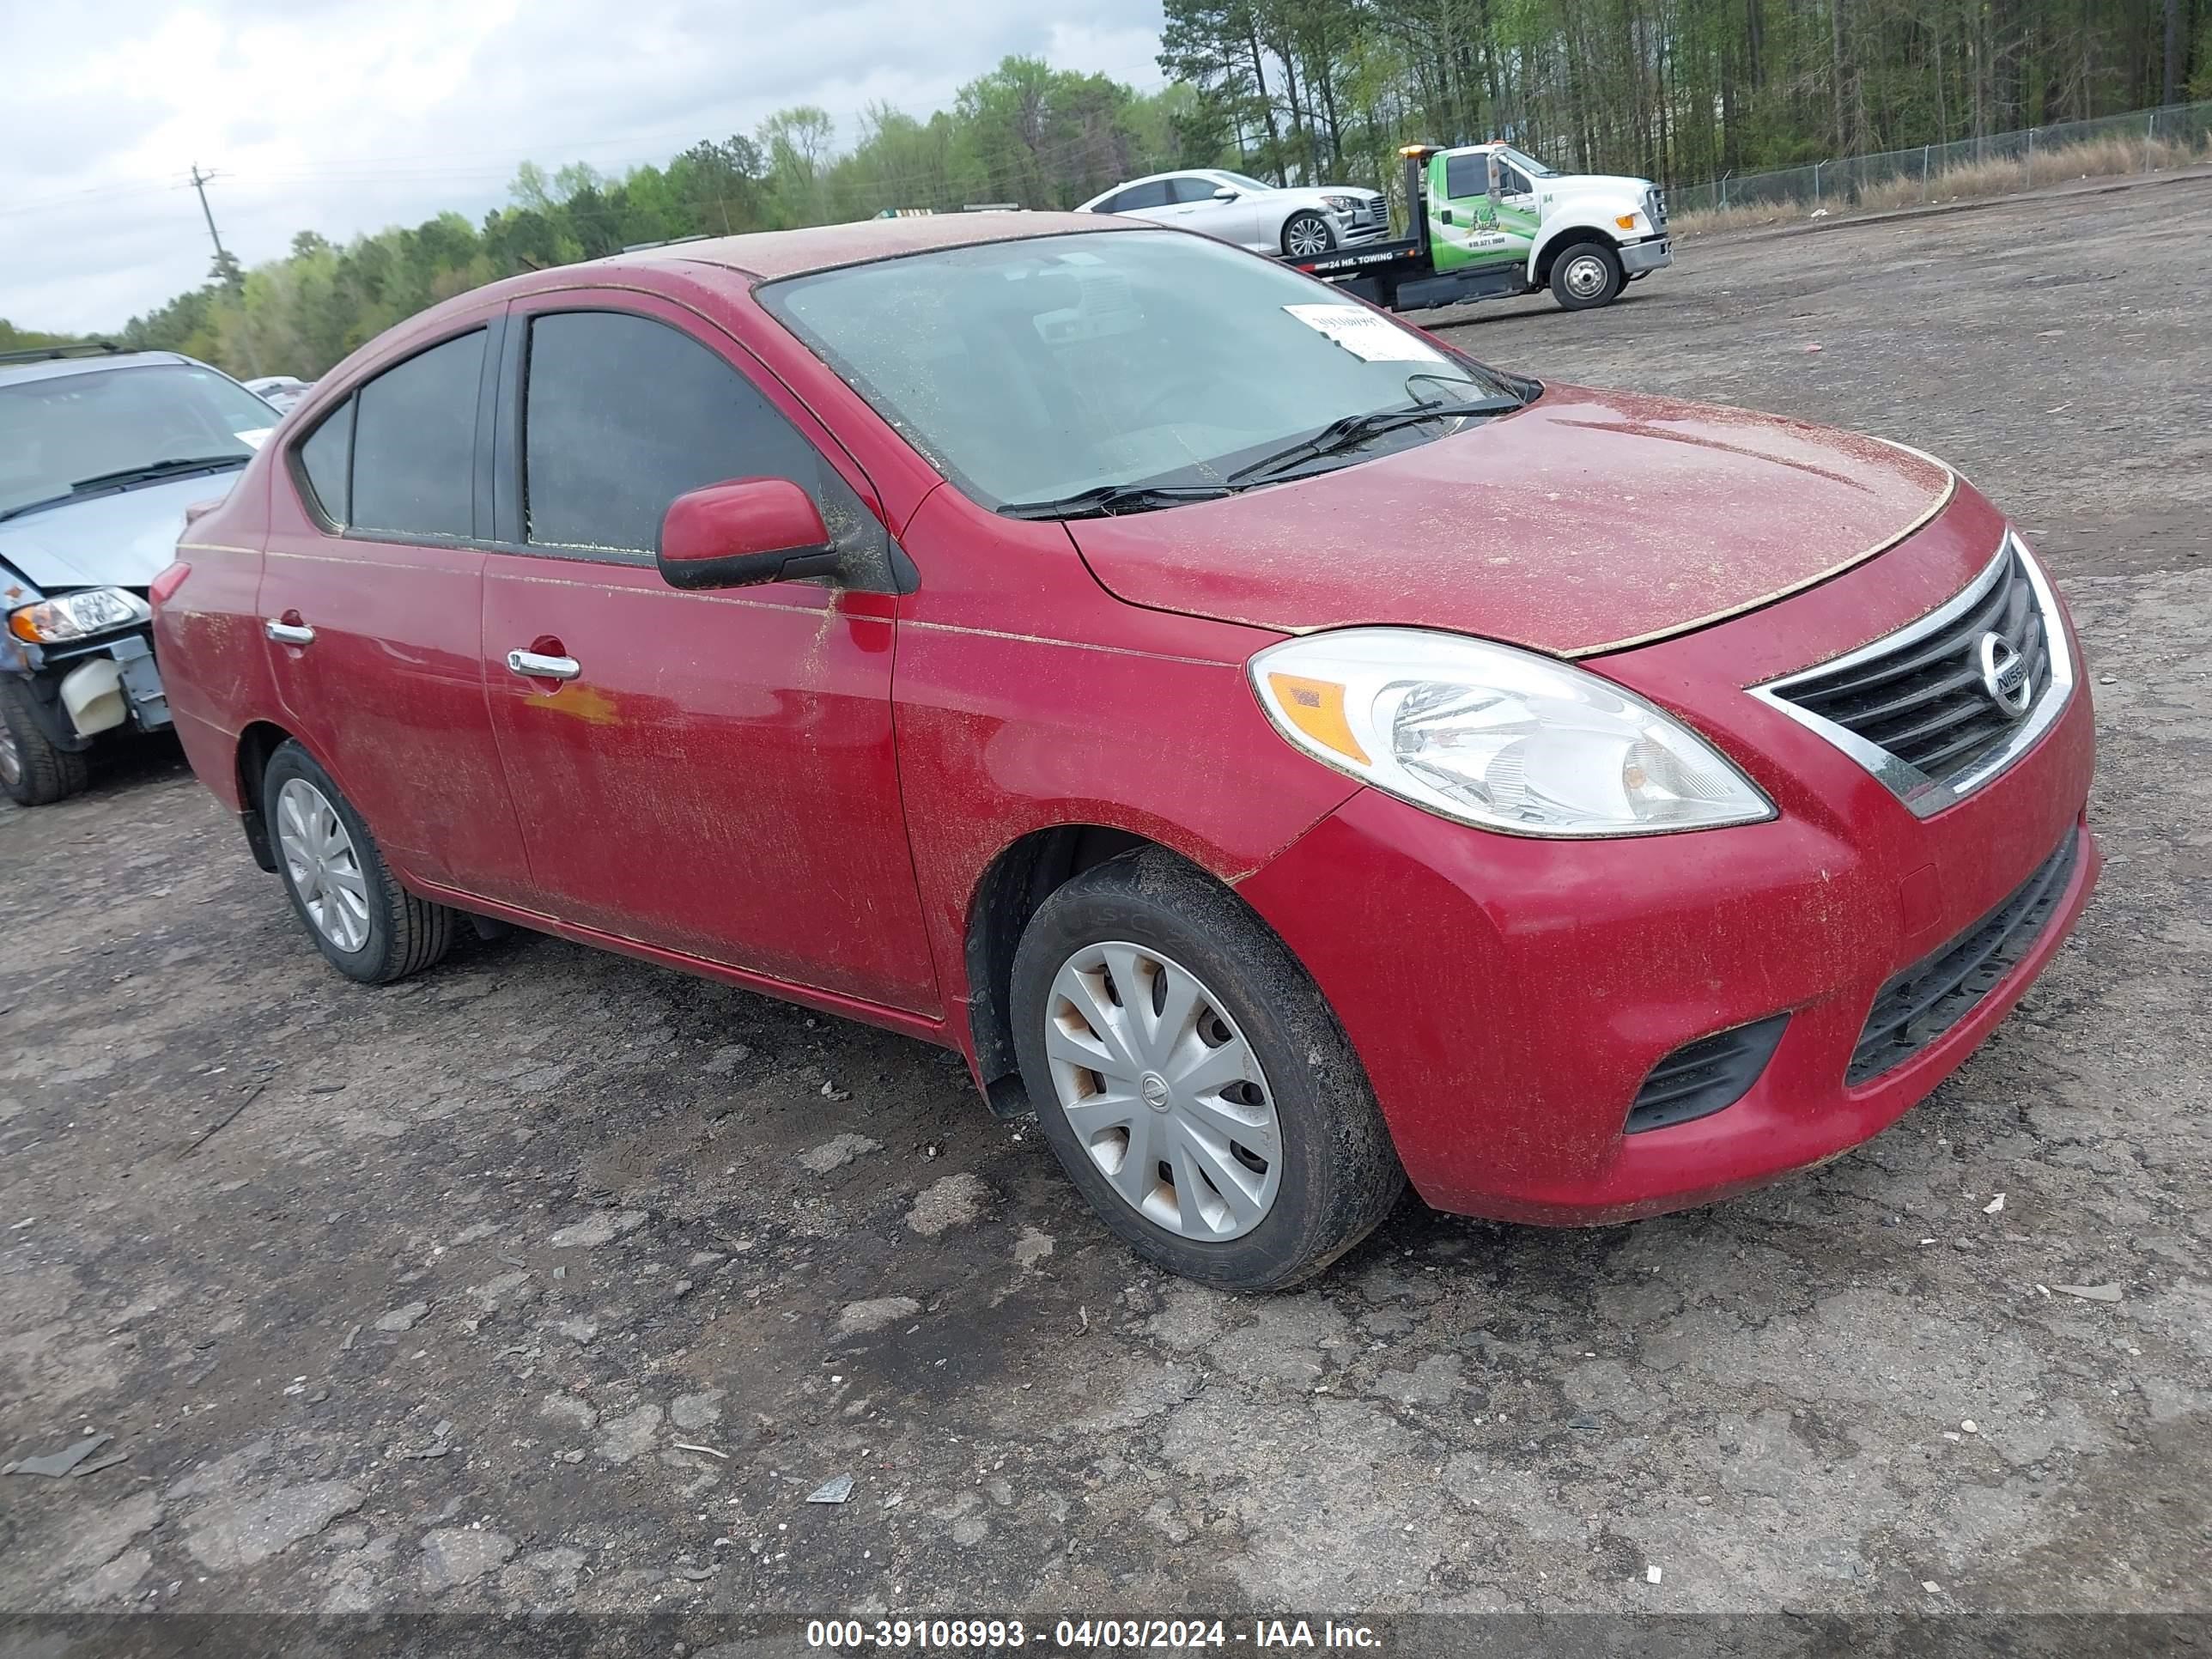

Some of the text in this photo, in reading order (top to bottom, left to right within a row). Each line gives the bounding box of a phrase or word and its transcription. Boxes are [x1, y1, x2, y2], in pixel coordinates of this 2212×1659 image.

[1471, 219, 1500, 230] Lucky
[1328, 252, 1393, 269] 24 HR. TOWING
[1997, 664, 2025, 690] NISS
